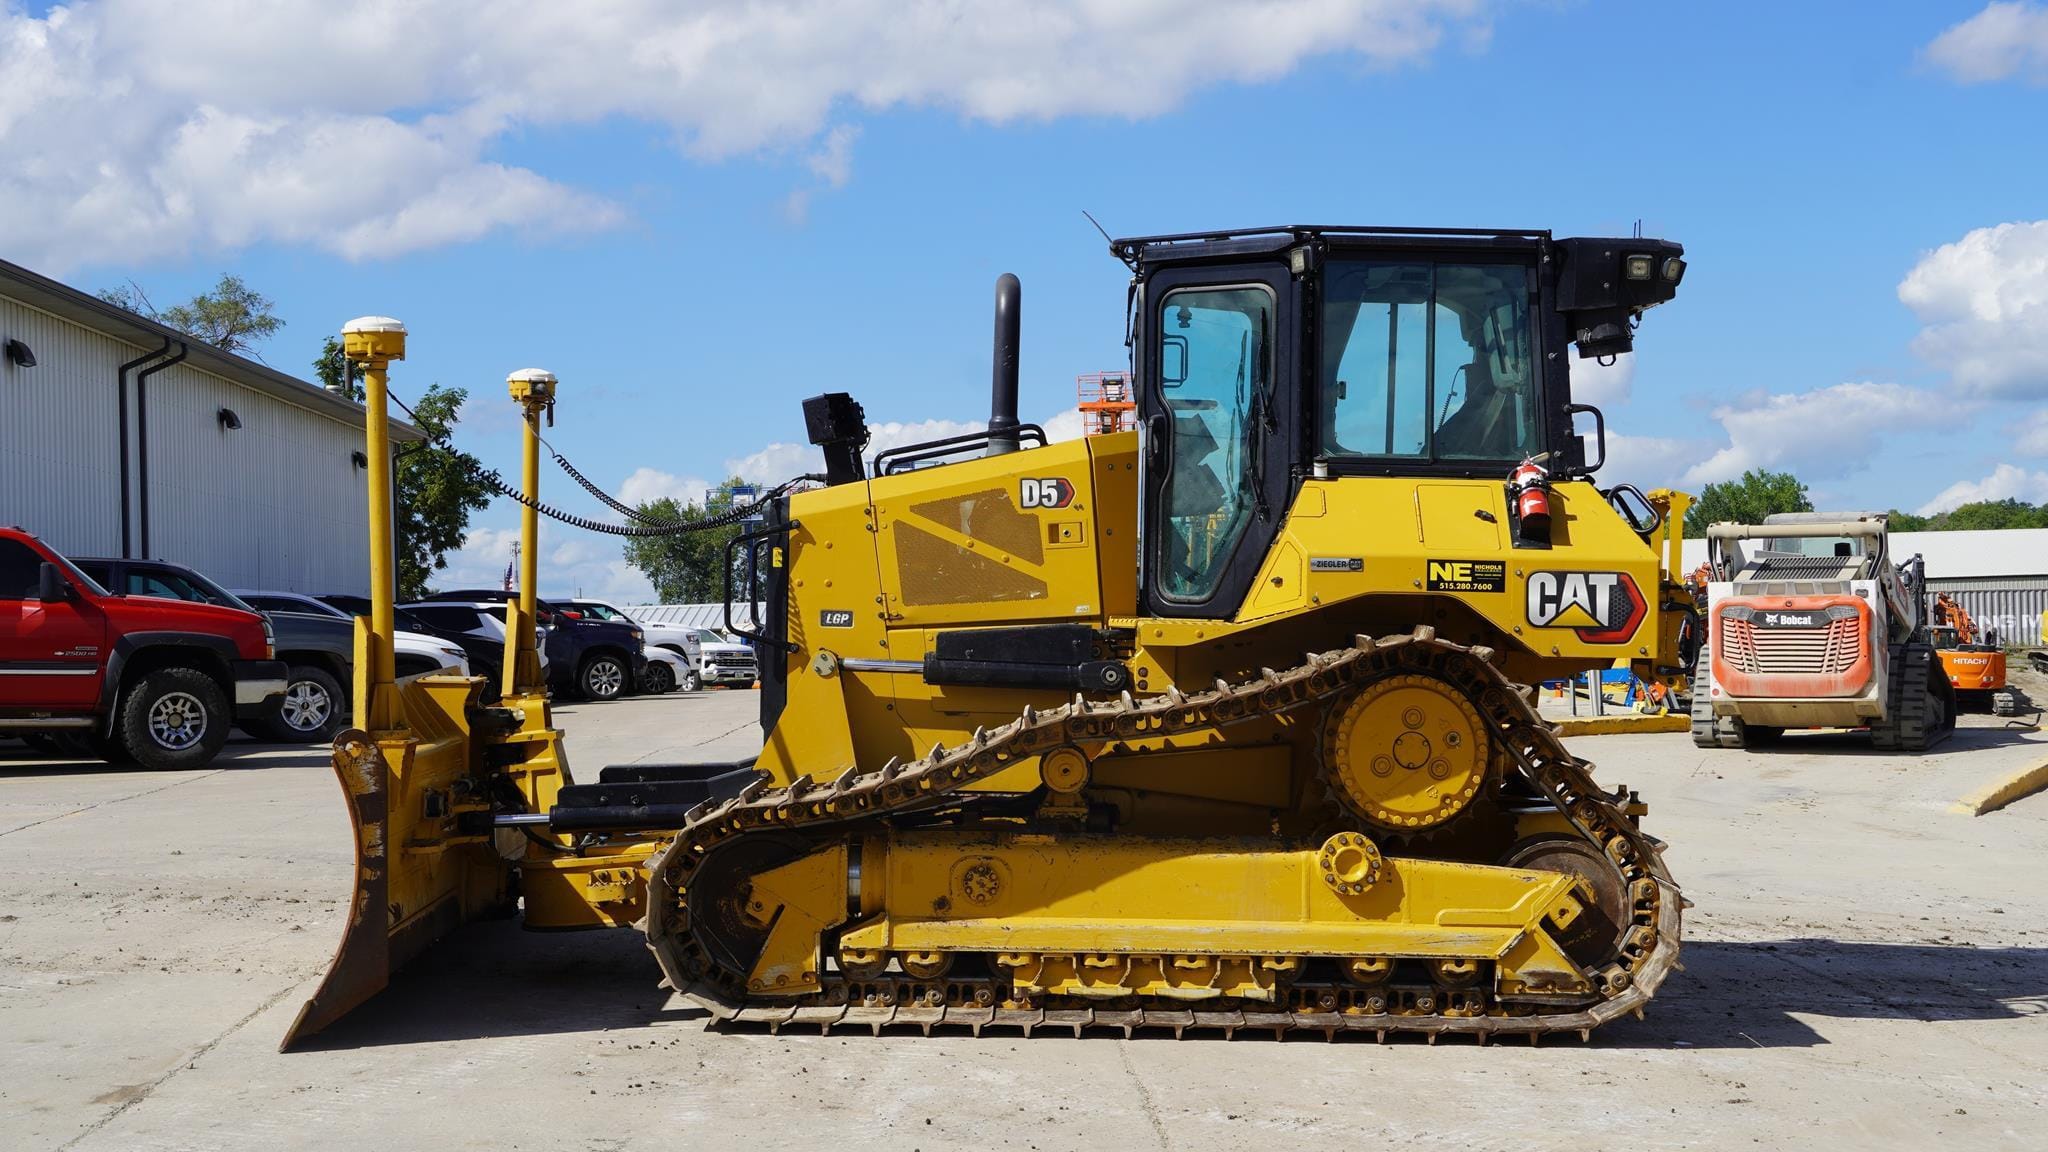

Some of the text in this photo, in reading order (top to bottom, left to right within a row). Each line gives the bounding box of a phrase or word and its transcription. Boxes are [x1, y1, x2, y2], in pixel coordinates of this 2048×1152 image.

[1021, 479, 1058, 507] D5
[1316, 560, 1347, 568] ZIEGLER
[1430, 562, 1472, 581] NE
[1440, 582, 1492, 590] 515.280.7600
[1528, 572, 1617, 627] CAT
[826, 613, 850, 624] LGP
[1780, 615, 1812, 625] Bobcat
